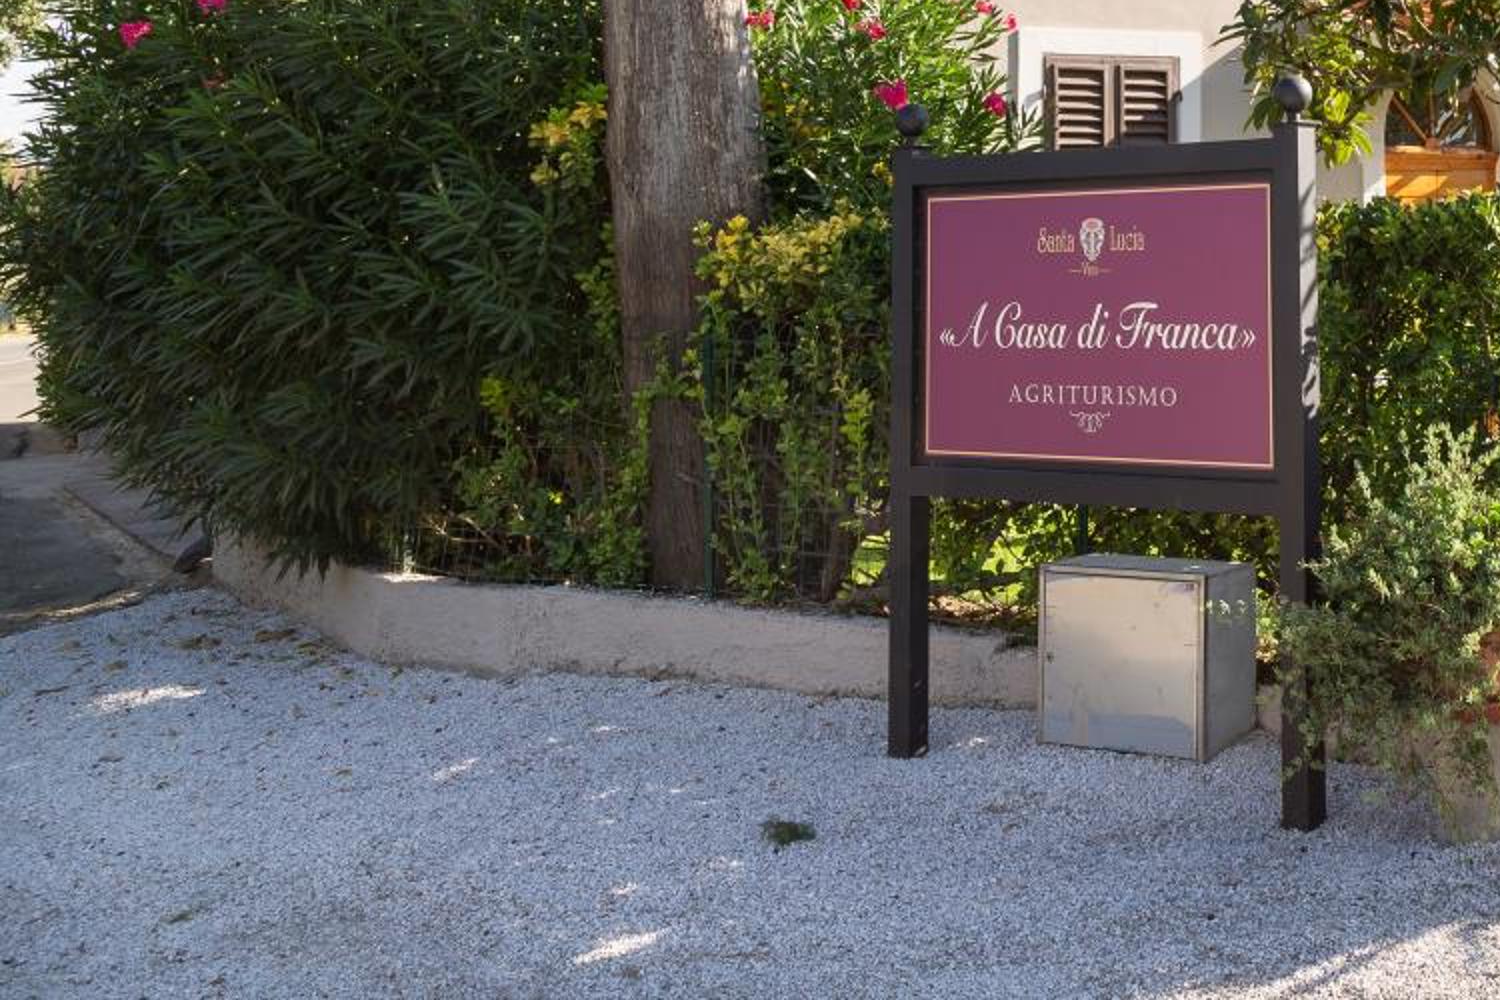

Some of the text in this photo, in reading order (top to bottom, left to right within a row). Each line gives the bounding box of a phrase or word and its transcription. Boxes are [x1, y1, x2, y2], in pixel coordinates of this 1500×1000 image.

[1037, 225, 1145, 253] Santa Lucia
[995, 301, 1071, 349] Casa
[1077, 303, 1109, 349] di
[1115, 301, 1256, 350] Franca»
[1009, 383, 1178, 407] AGRITURISMO
